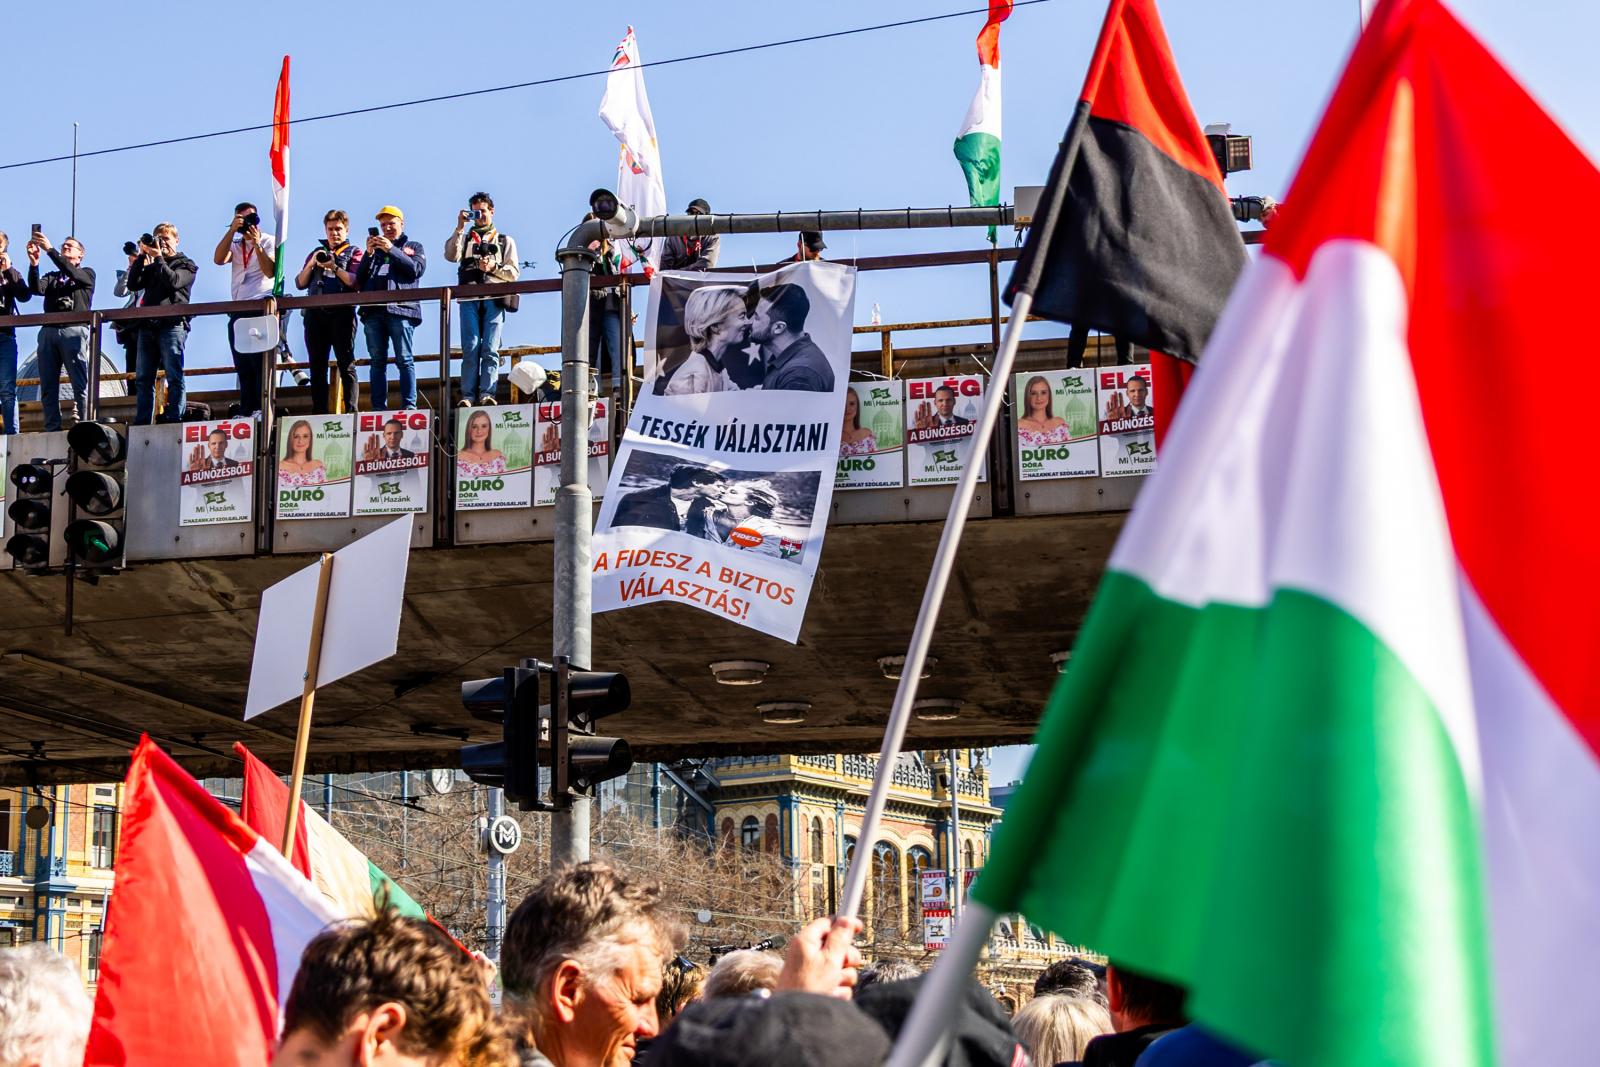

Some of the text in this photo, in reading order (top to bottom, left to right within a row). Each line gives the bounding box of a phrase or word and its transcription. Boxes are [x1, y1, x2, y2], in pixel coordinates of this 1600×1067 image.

[1100, 367, 1152, 390] ELÉ
[1068, 387, 1092, 395] Hazánk
[639, 415, 829, 454] TESSÉK VÁLASZTANI
[1102, 423, 1110, 433] A
[910, 432, 917, 441] A
[537, 455, 545, 464] A
[1021, 445, 1070, 462] DÚRÓ
[358, 463, 365, 473] A
[836, 456, 875, 472] ÚRÓ
[184, 475, 191, 483] A
[459, 477, 504, 492] DÚRÓ
[280, 486, 324, 502] DÚRÓ
[384, 495, 411, 503] Hazánk
[732, 531, 763, 543] FIDESZ
[593, 549, 795, 606] A FIDESZ A BIZTOS
[620, 571, 751, 620] VÁLASZTÁS!
